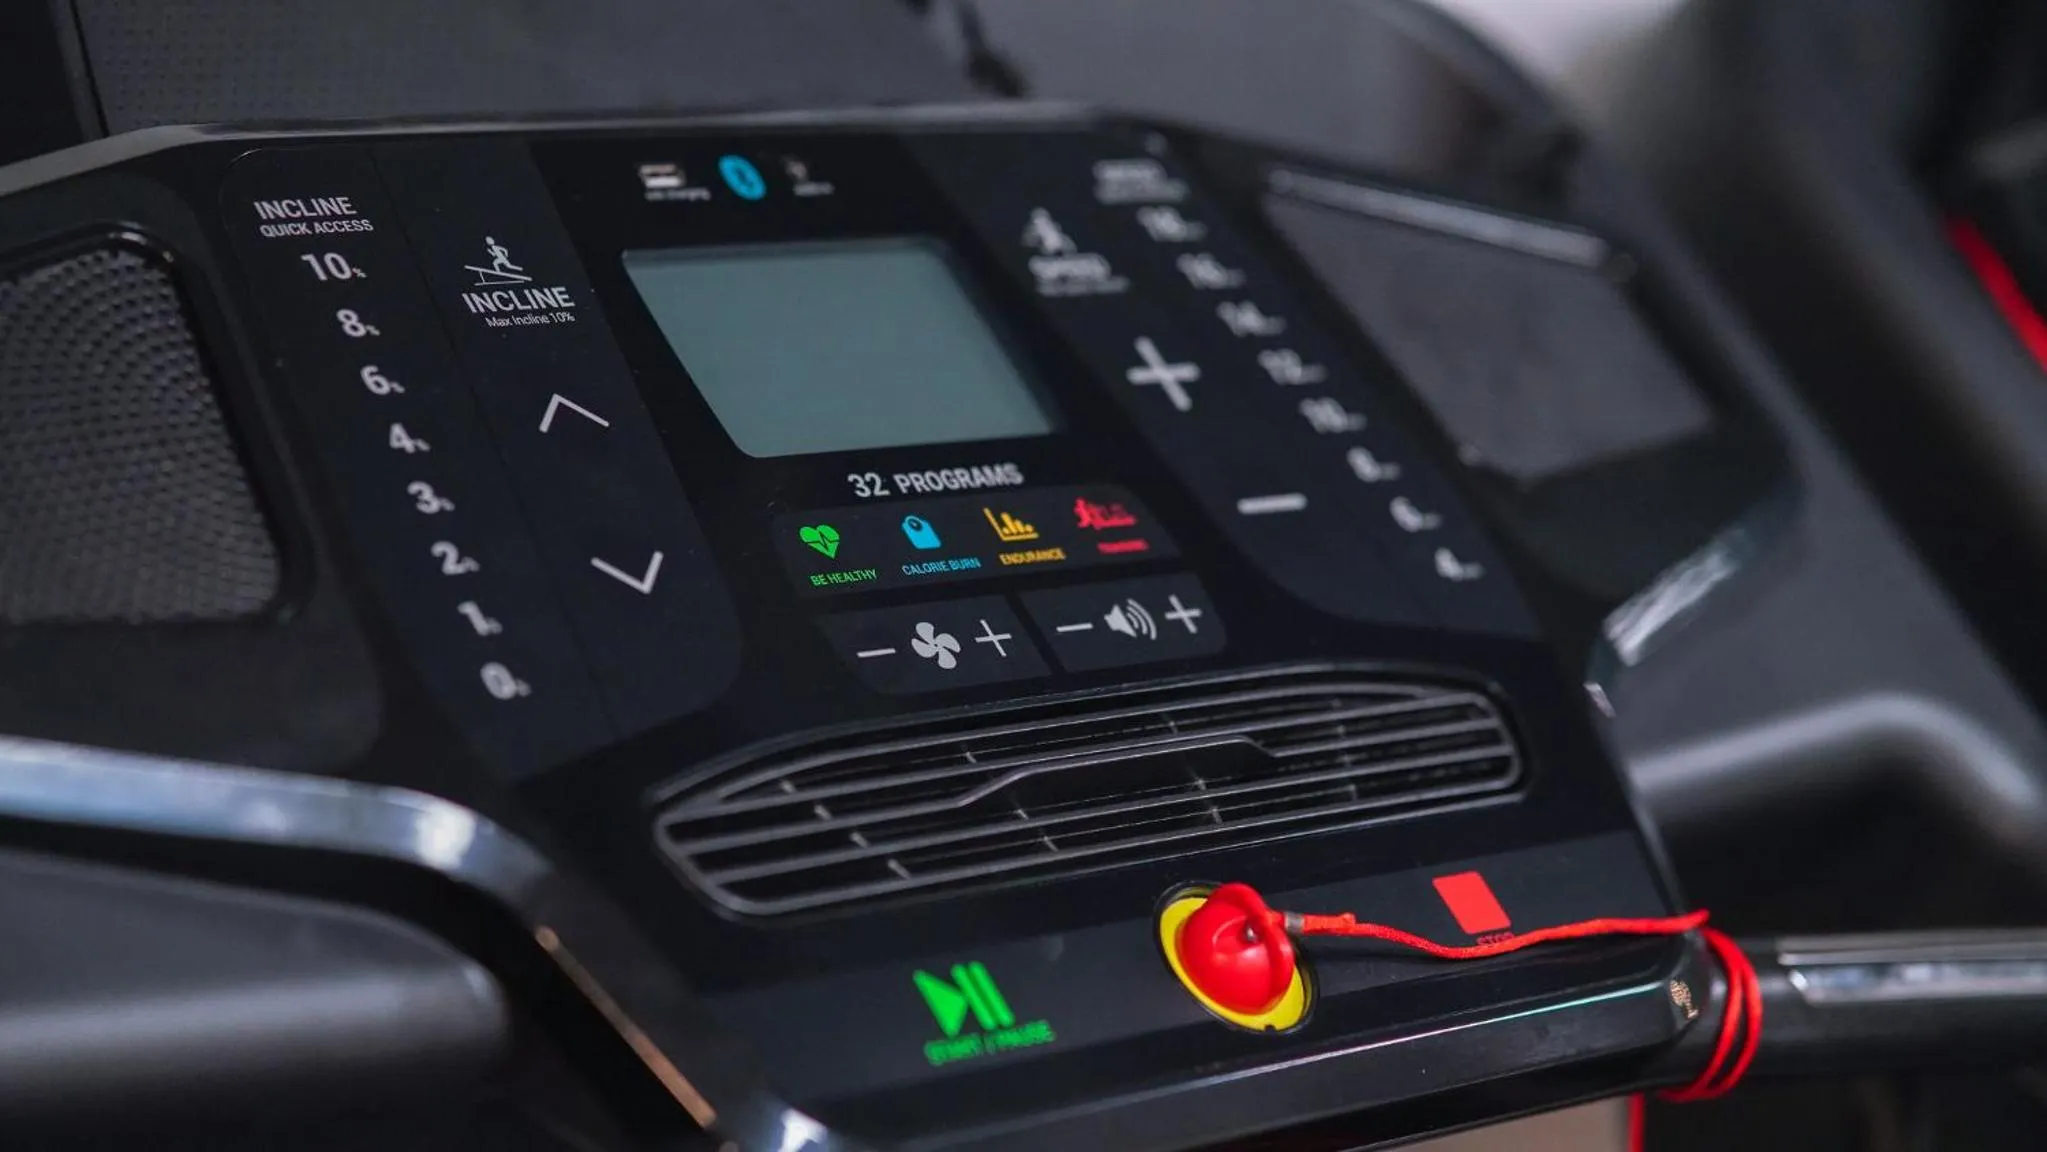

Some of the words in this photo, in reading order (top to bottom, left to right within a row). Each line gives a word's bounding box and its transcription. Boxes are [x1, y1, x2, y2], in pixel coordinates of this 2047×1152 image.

[253, 196, 358, 220] INCLINE
[259, 221, 313, 238] QUICK
[313, 218, 375, 234] ACCESS
[461, 286, 576, 314] INCLINE
[485, 316, 511, 328] Max
[511, 313, 550, 326] Incline
[549, 311, 576, 324] 10%
[847, 471, 891, 498] 32
[893, 462, 1024, 494] PROGRAMS
[901, 560, 949, 576] CALORIE
[949, 556, 982, 572] BURN
[999, 548, 1067, 565] ENDURANCE
[809, 573, 828, 587] BE
[826, 568, 877, 585] HEALTHY
